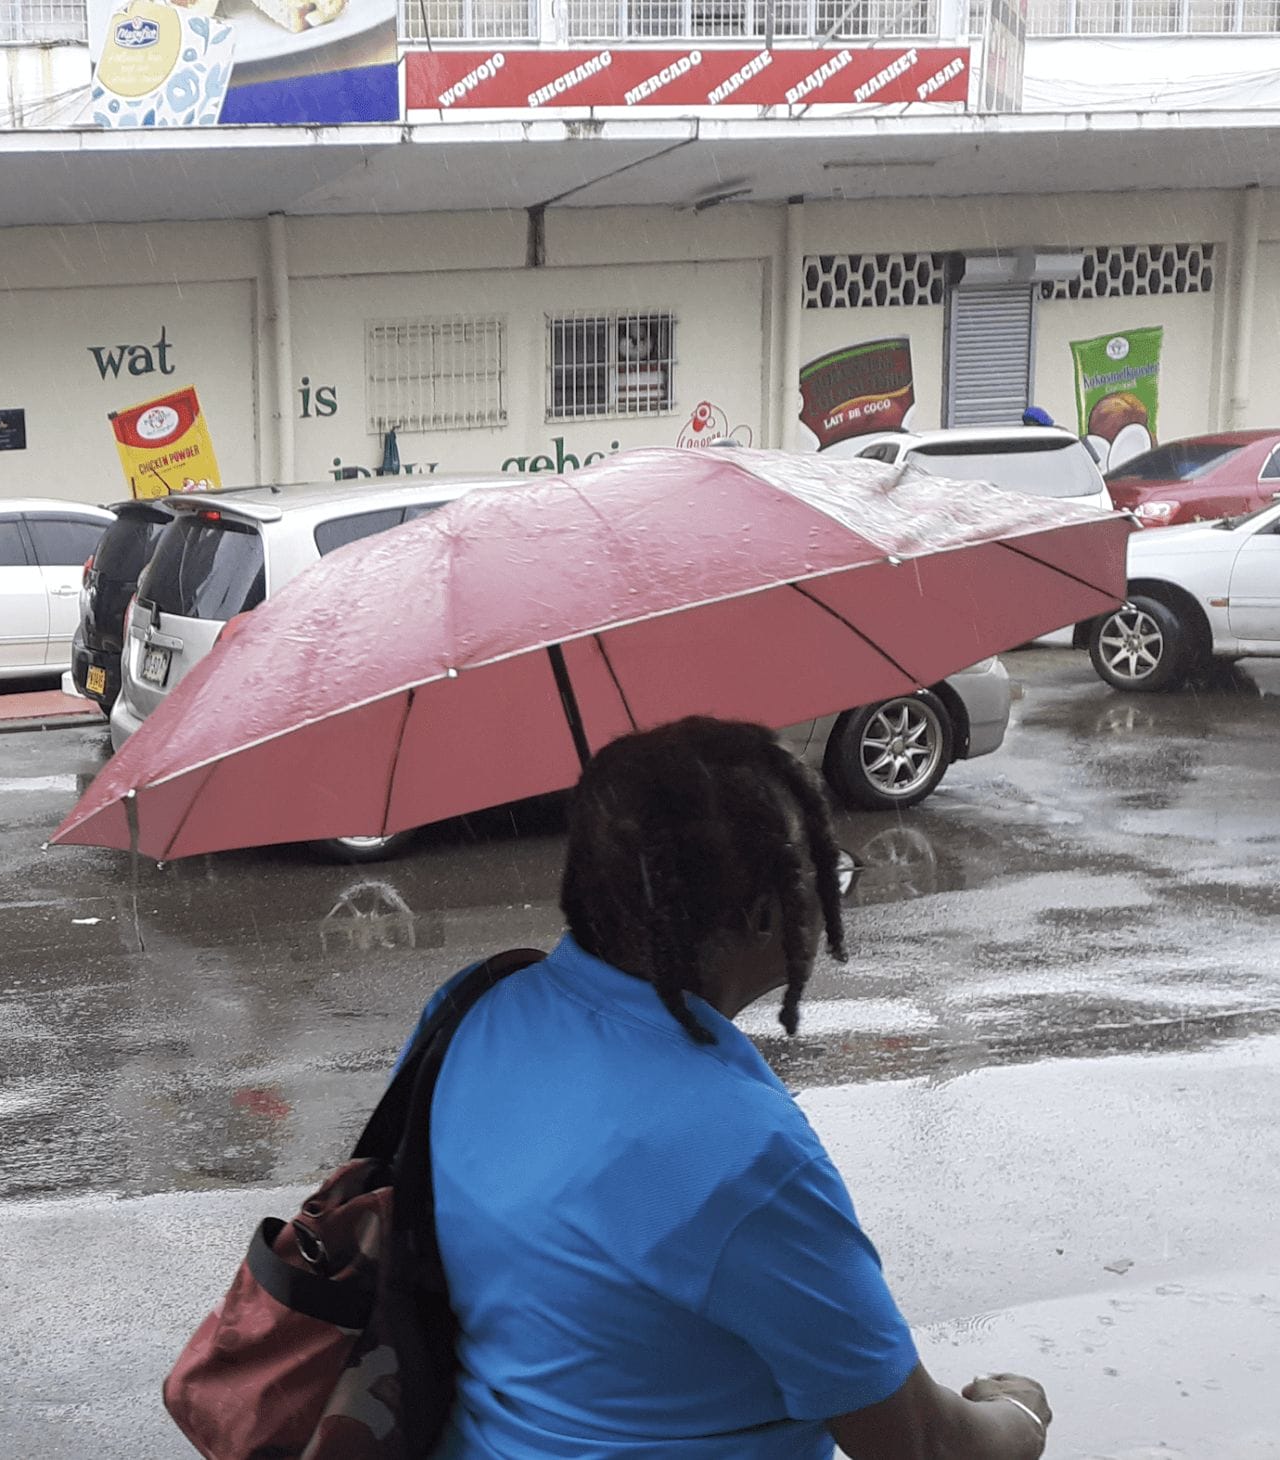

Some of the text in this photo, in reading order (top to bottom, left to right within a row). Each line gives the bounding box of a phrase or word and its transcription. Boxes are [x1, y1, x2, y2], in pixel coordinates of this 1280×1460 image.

[438, 52, 505, 107] WOWOJO
[623, 50, 703, 106] MERCADO
[707, 49, 773, 105] MARCHE
[785, 50, 853, 105] BAAJAAR
[853, 48, 918, 103] MARKET
[916, 57, 965, 101] PASAR
[87, 325, 176, 380] wat
[297, 376, 338, 418] is
[823, 398, 891, 430] LAIT DE COCO
